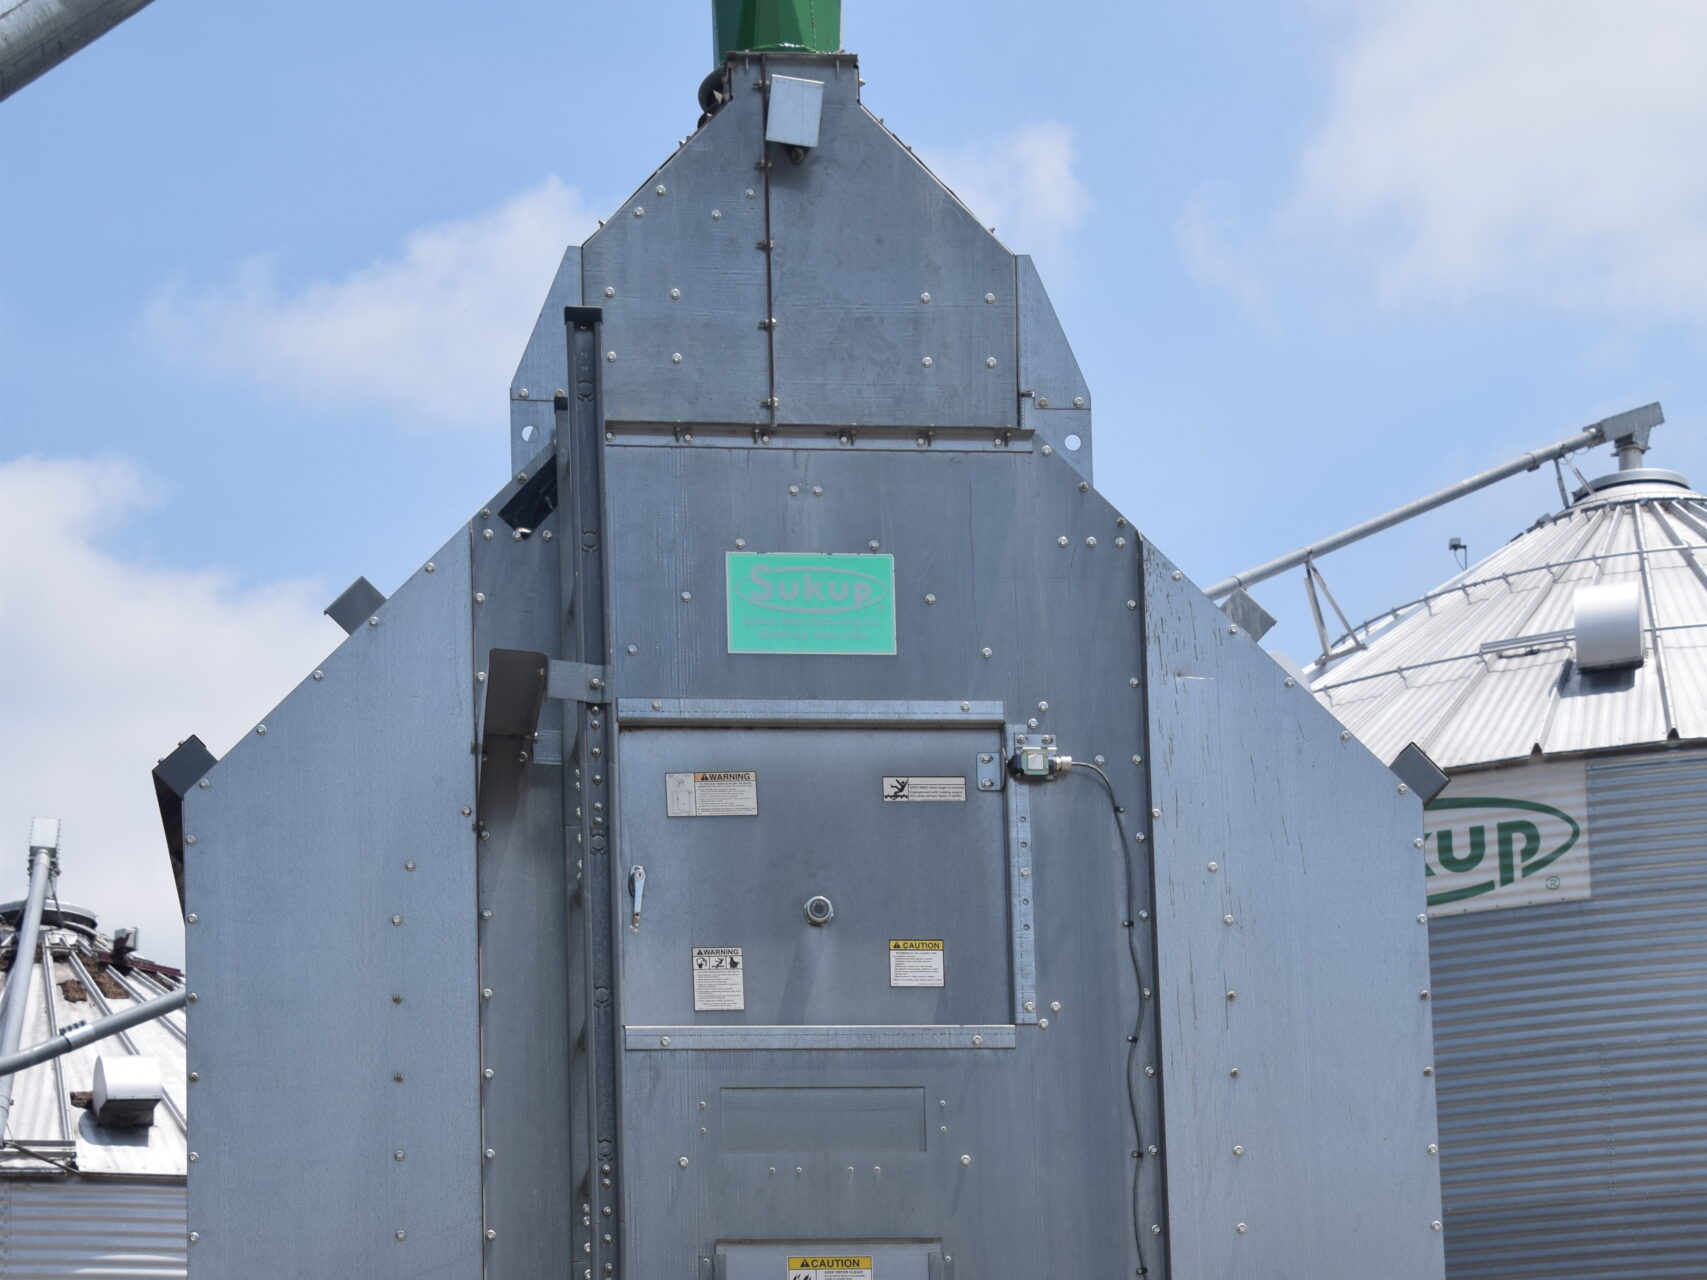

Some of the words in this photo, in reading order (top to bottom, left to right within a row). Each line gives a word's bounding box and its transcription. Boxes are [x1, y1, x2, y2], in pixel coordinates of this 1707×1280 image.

[750, 564, 872, 610] Sukup
[709, 773, 750, 781] WARNING
[811, 1259, 860, 1268] CAUTION
